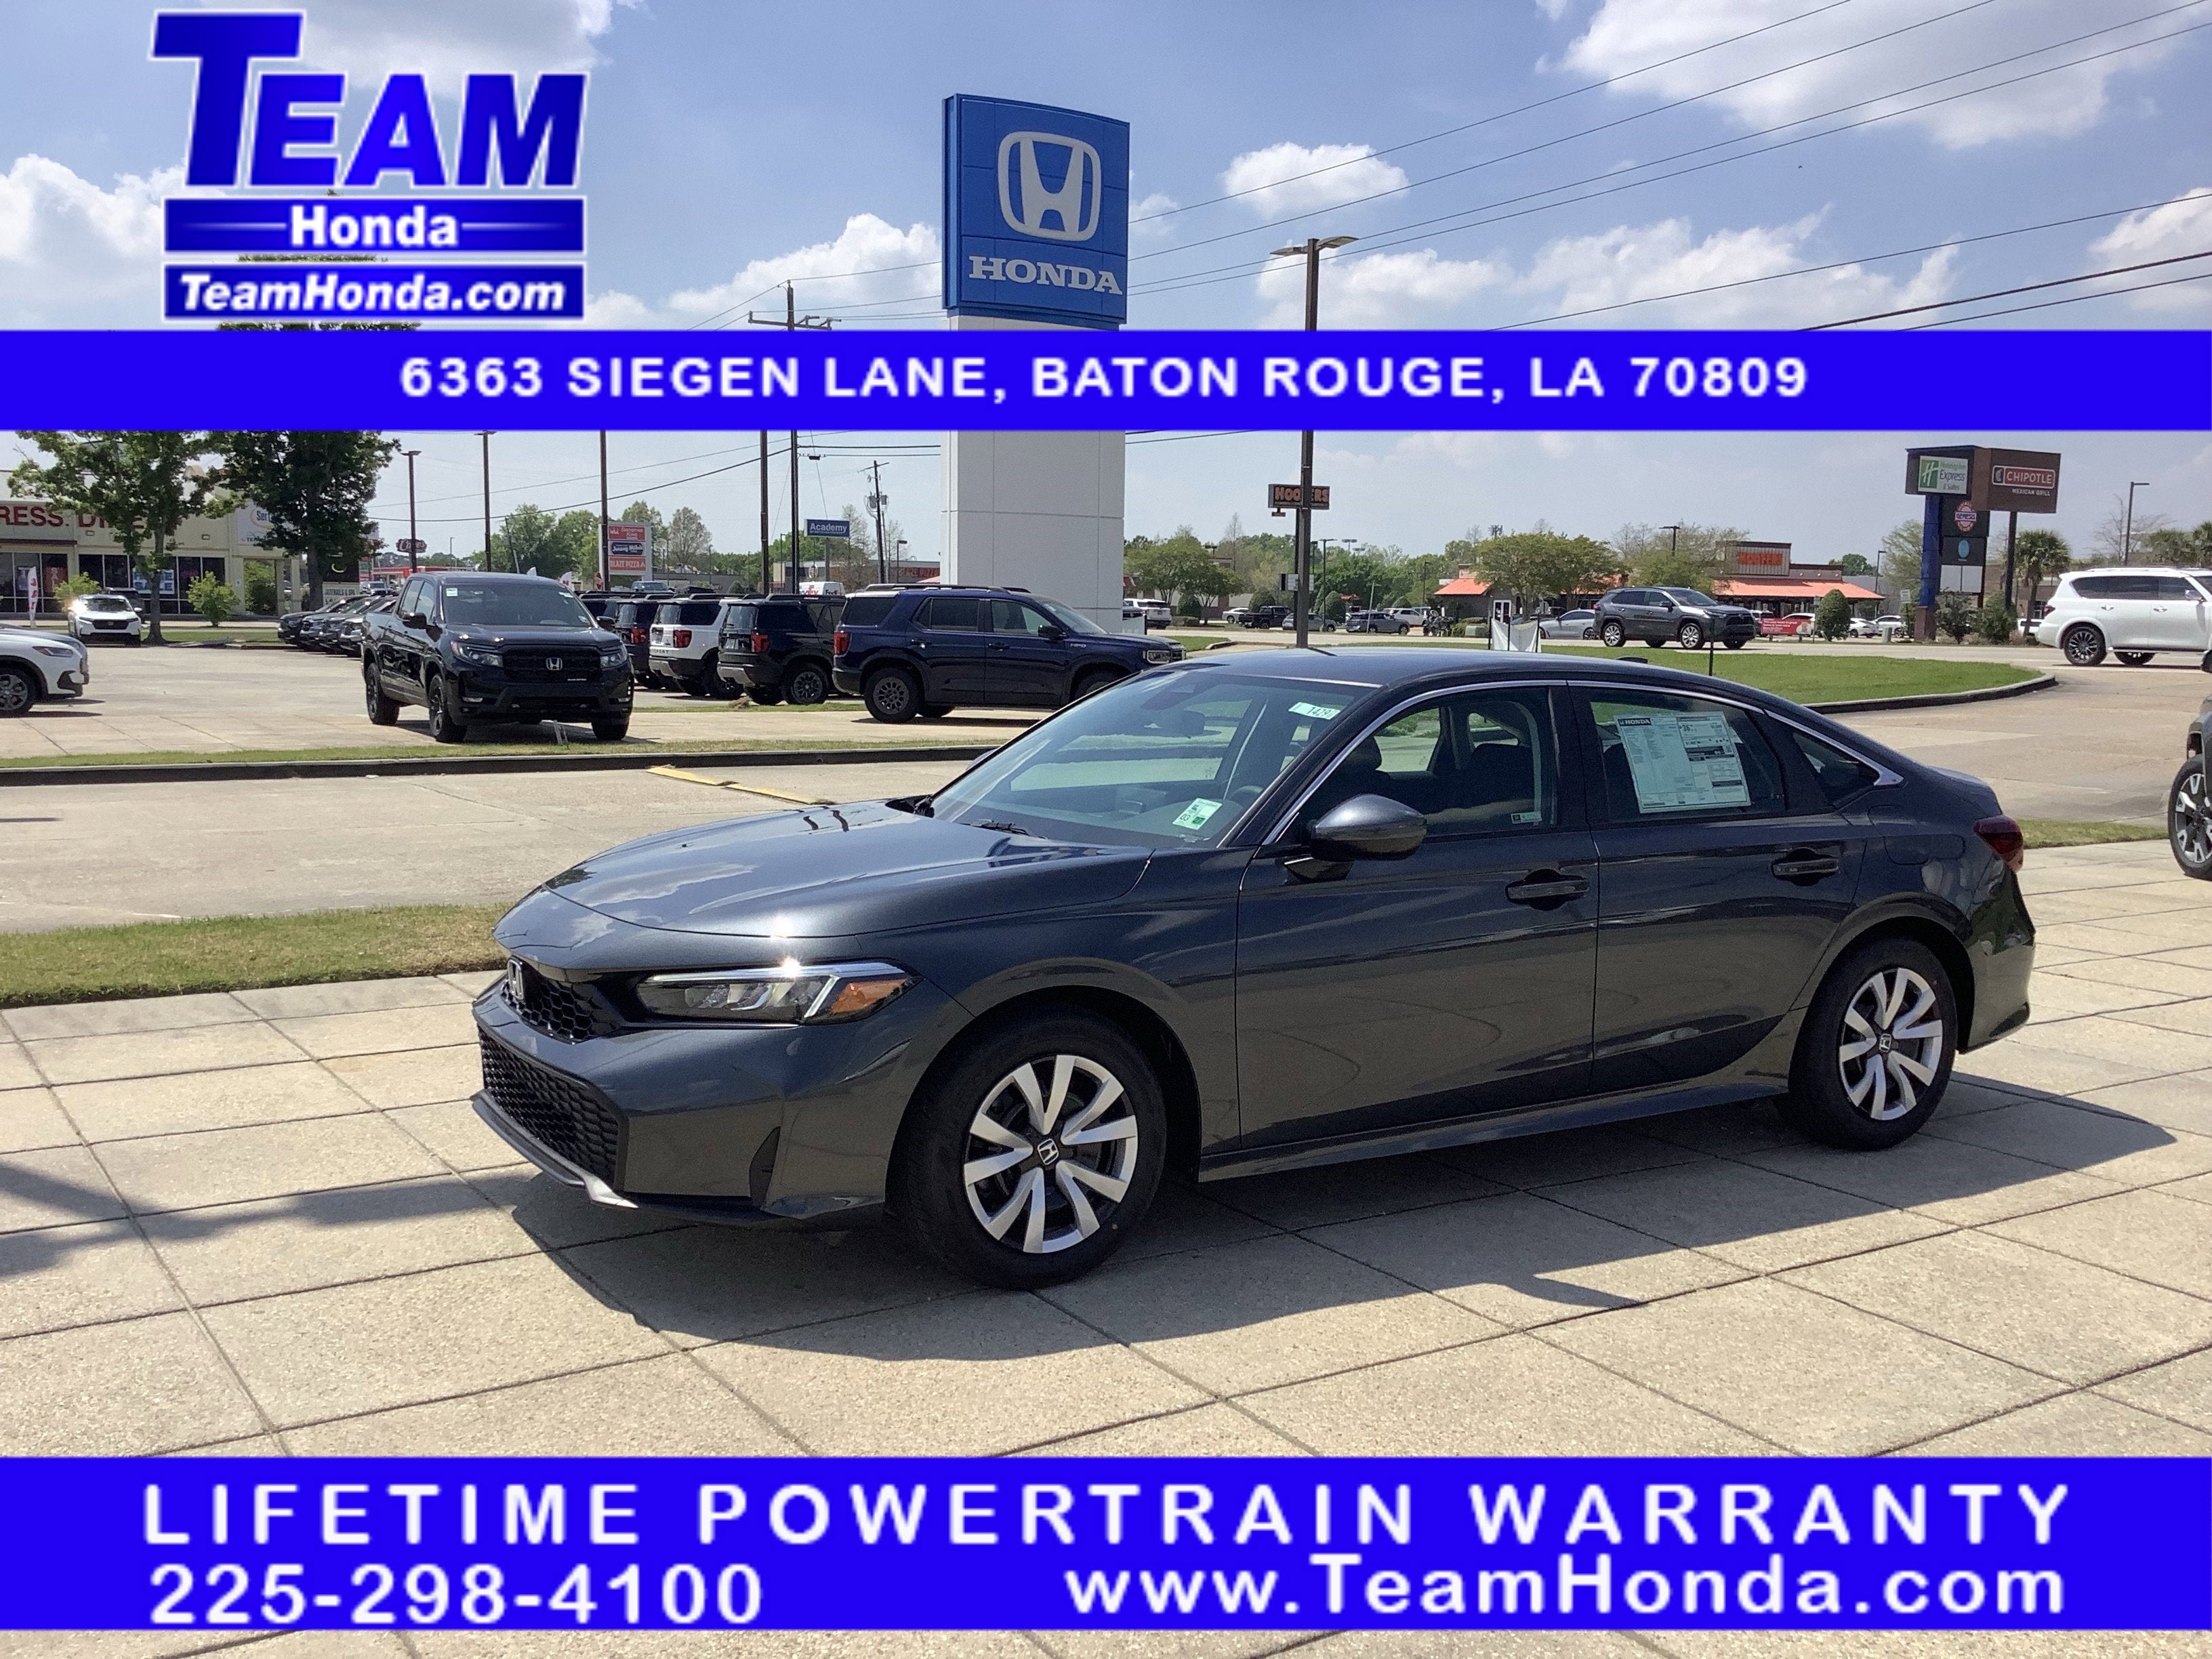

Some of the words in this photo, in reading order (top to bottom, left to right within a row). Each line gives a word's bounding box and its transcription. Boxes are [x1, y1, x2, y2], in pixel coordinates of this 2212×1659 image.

[968, 255, 1122, 295] HONDA
[1940, 470, 1965, 482] Express
[2006, 471, 2053, 484] CHIPOTLE
[1275, 487, 1329, 503] HOORS
[810, 523, 847, 533] Academy
